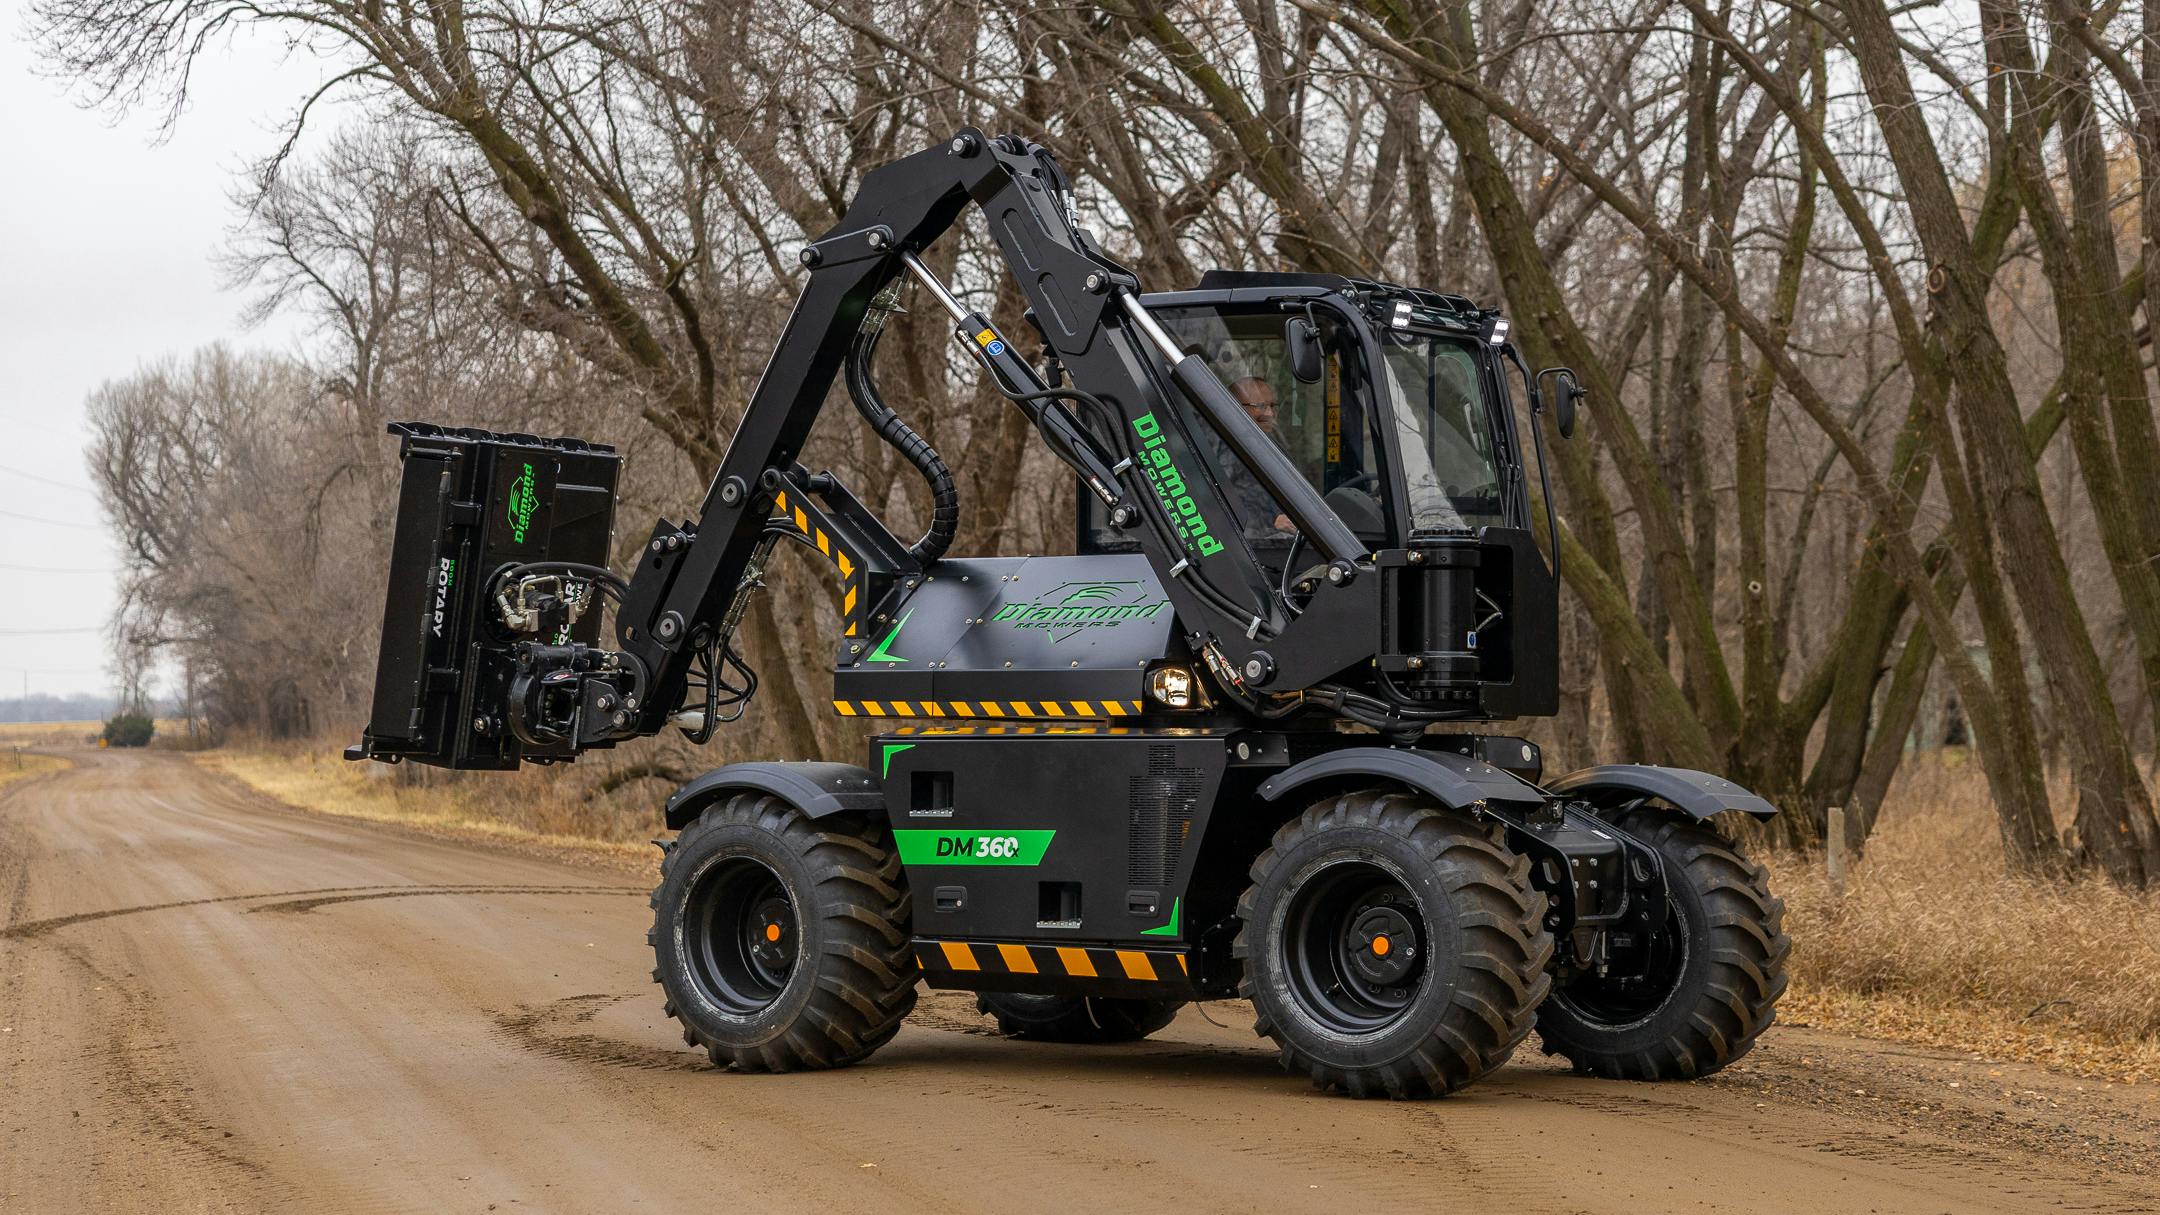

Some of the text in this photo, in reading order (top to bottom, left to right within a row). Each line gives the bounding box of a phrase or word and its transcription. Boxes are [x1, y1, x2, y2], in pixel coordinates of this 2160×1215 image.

[514, 463, 532, 544] Diamond
[1132, 411, 1224, 557] Diamond
[433, 557, 450, 638] ROTARY
[447, 559, 455, 586] BOOM
[991, 600, 1172, 622] Diamond
[1013, 621, 1121, 629] MOWERS
